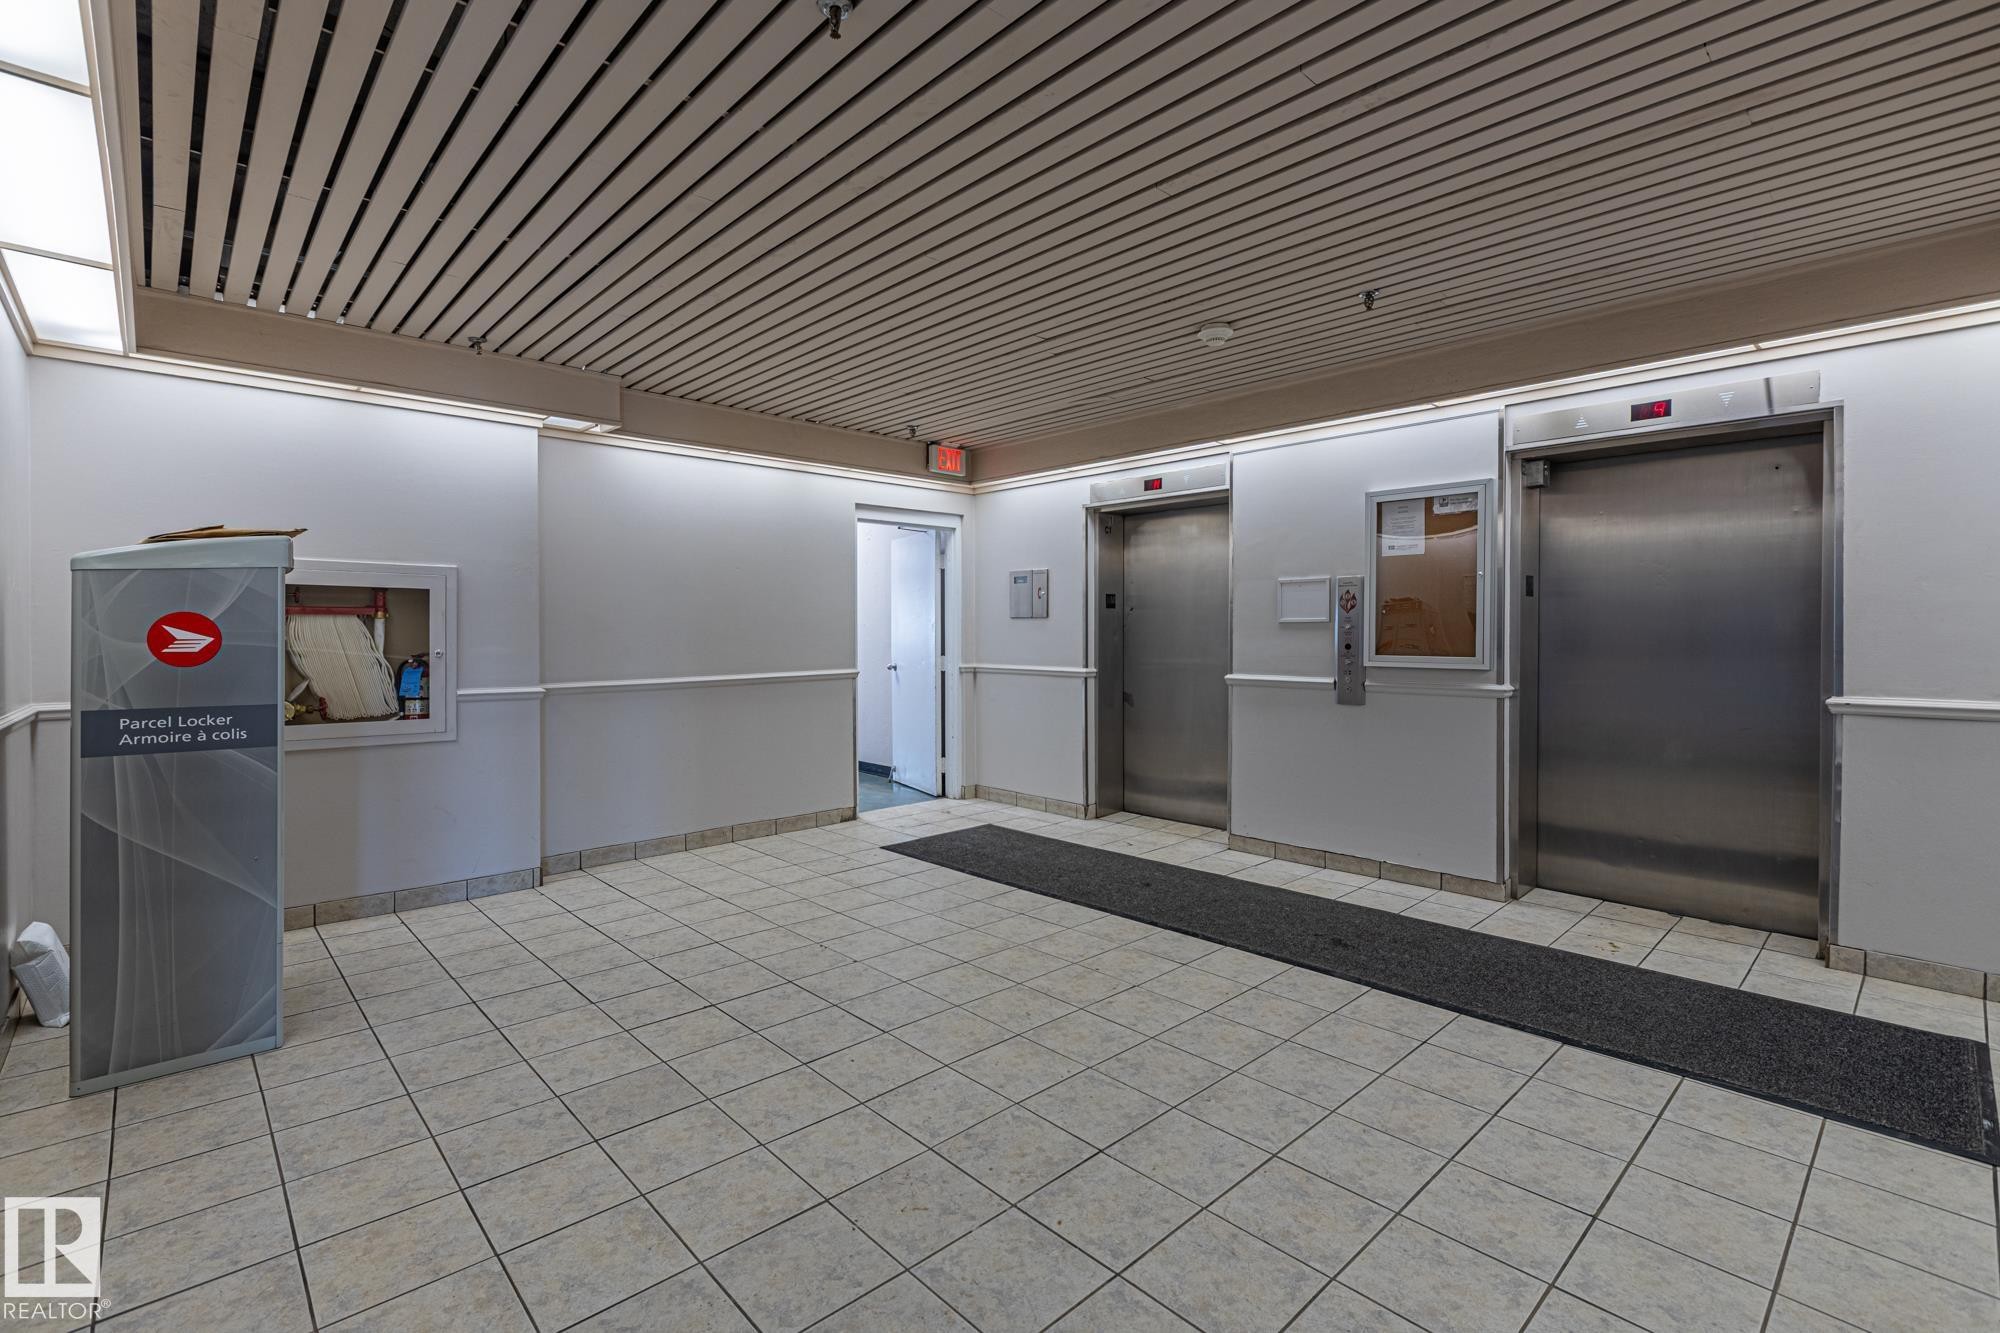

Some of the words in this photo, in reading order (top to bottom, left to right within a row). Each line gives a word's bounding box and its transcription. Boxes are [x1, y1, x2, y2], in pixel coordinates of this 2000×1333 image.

[937, 447, 961, 471] EXIT
[119, 715, 172, 730] Parcel
[178, 714, 233, 727] Locker
[119, 731, 192, 746] Armoire
[197, 730, 207, 741] à
[211, 728, 248, 741] colis
